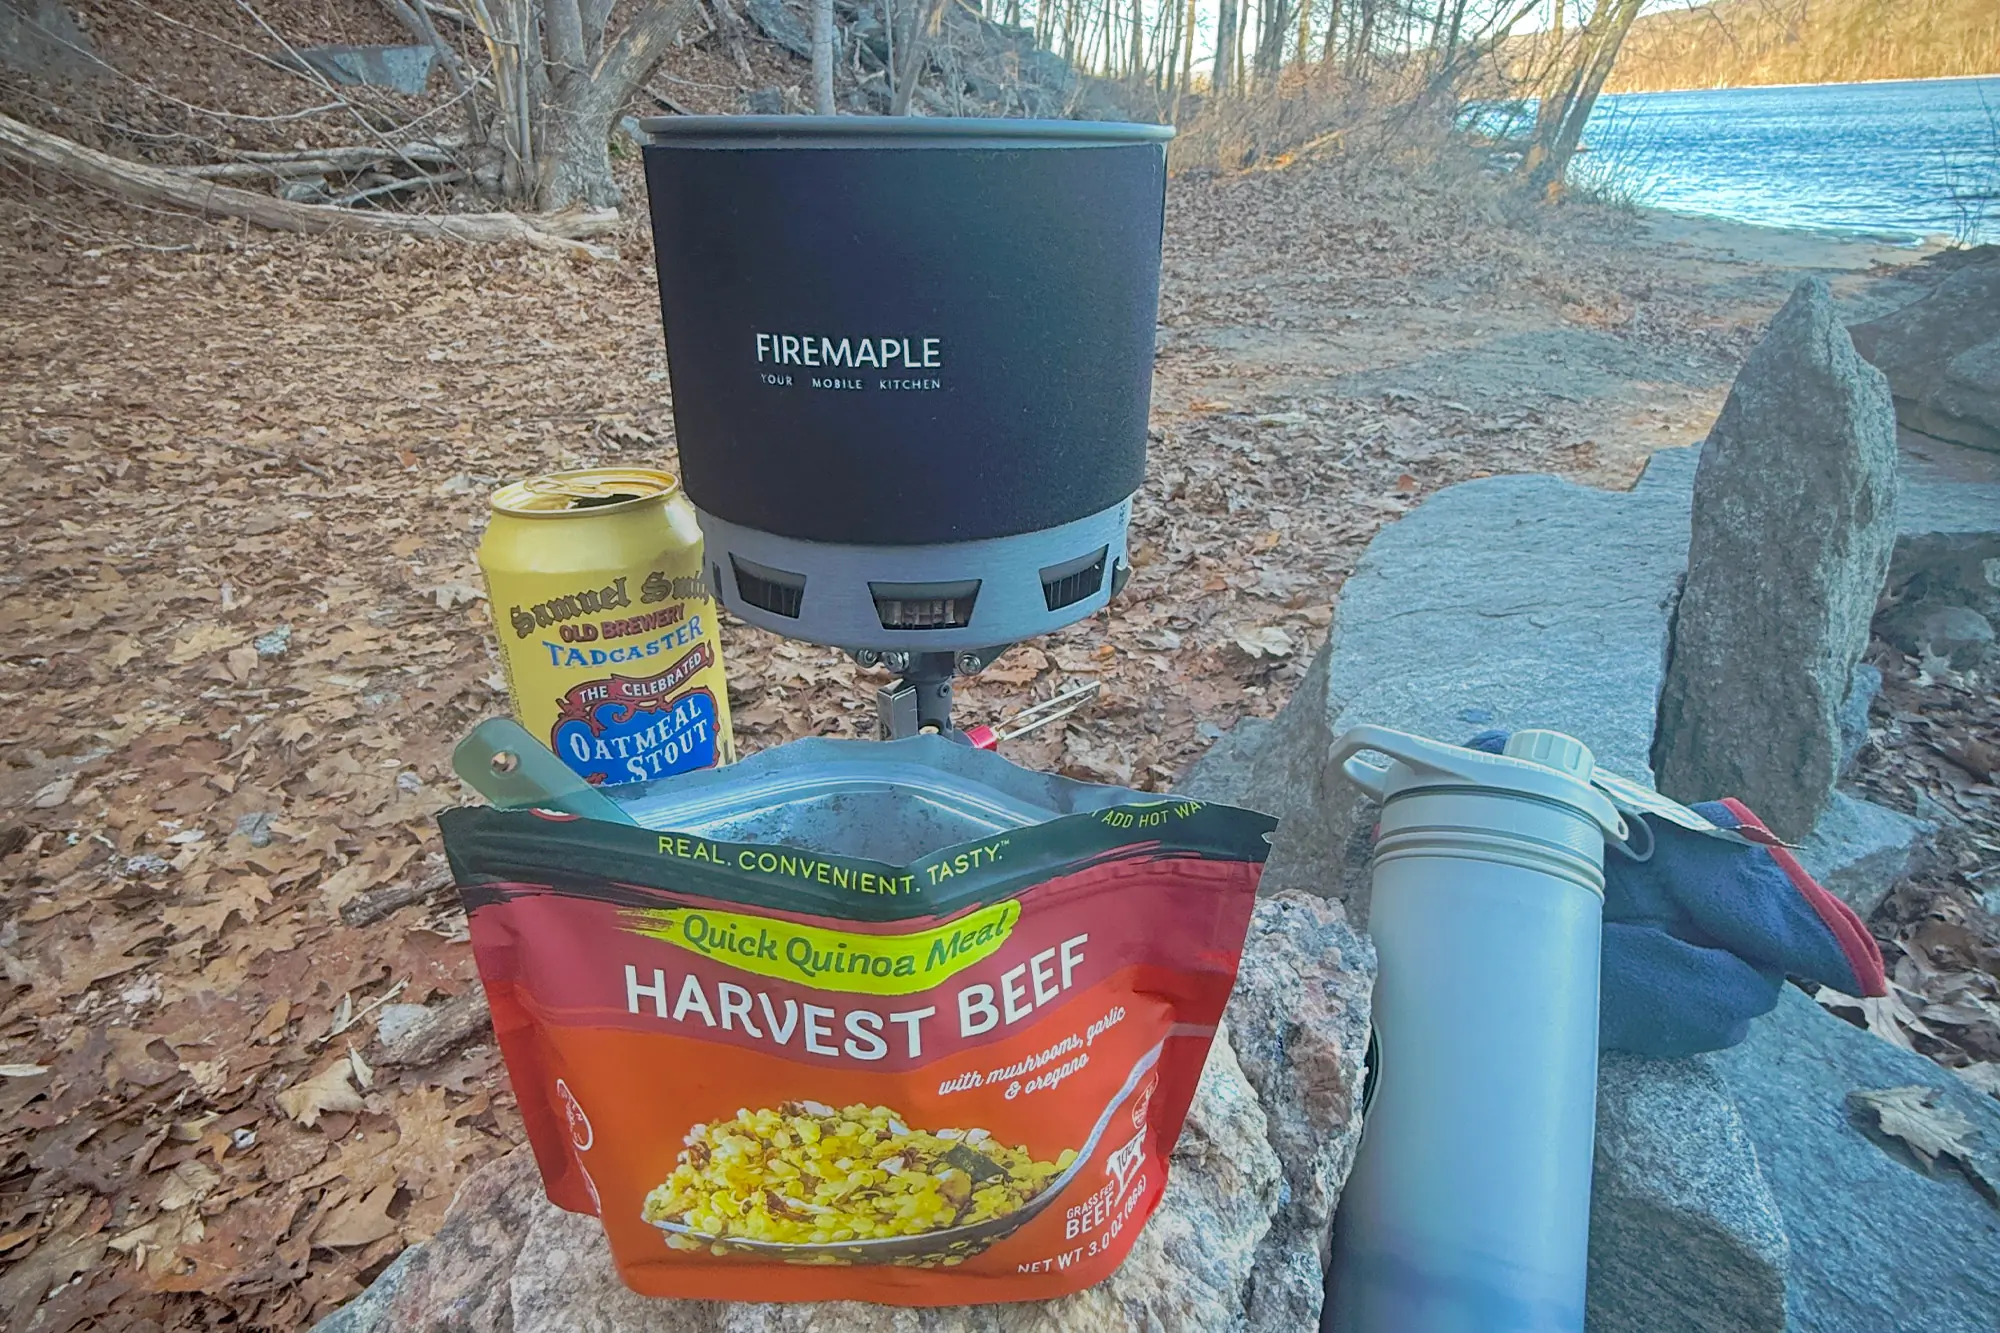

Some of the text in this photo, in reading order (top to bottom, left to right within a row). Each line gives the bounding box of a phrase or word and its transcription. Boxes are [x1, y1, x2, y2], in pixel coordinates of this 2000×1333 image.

[756, 333, 941, 368] FIREMAPLE
[760, 373, 941, 390] YOUR MOBILE KITCHEN
[510, 577, 632, 639] Samuel
[559, 602, 685, 643] OLD BREWERY
[542, 615, 704, 667] TADCASTER
[580, 652, 702, 703] THE CELEBRATED
[570, 697, 702, 762] OATMEAL
[626, 718, 707, 782] STOUT
[1101, 810, 1134, 828] ADD
[1138, 810, 1169, 828] HOT
[658, 835, 731, 866] REAL.
[738, 850, 920, 896] CONVENIENT.
[683, 909, 1010, 977] Quick Quinoa Meal
[624, 933, 1089, 1060] HARVEST BEEF
[938, 1006, 1126, 1095] with mushrooms, garlic
[1005, 1053, 1090, 1100] & oregano
[1066, 1191, 1114, 1239] BEEF
[1067, 1193, 1098, 1219] GRASS
[1017, 1258, 1053, 1273] NET
[1058, 1247, 1083, 1270] WT
[1088, 1232, 1109, 1256] 3.0
[1111, 1211, 1123, 1238] OZ
